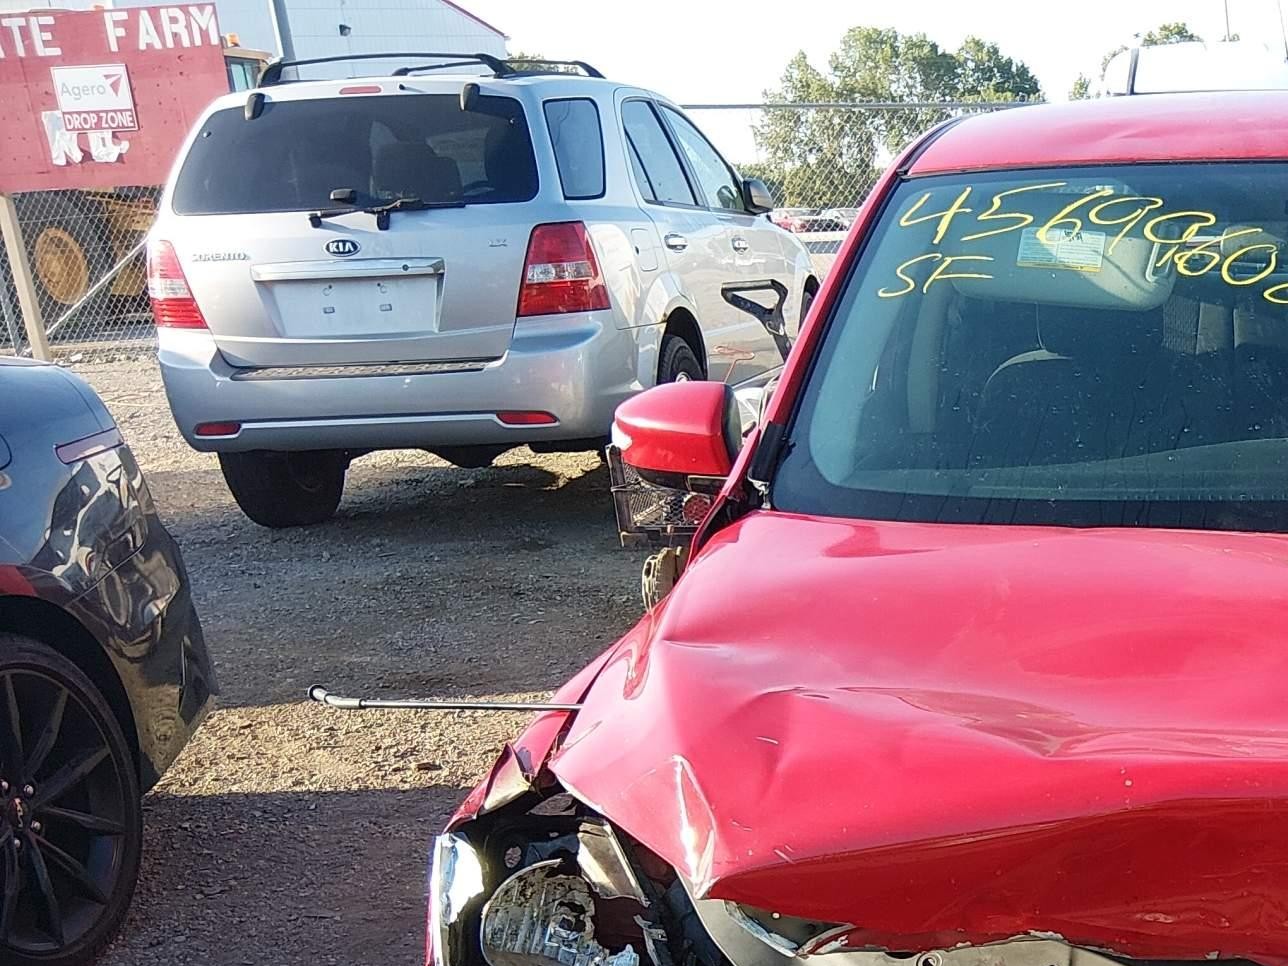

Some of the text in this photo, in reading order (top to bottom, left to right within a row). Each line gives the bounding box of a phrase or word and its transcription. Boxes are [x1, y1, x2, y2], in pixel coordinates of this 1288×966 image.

[0, 5, 219, 58] TE FARM
[61, 82, 106, 100] Agero
[64, 111, 135, 130] DROP ZONE
[329, 241, 354, 253] KIA
[878, 253, 994, 297] SF
